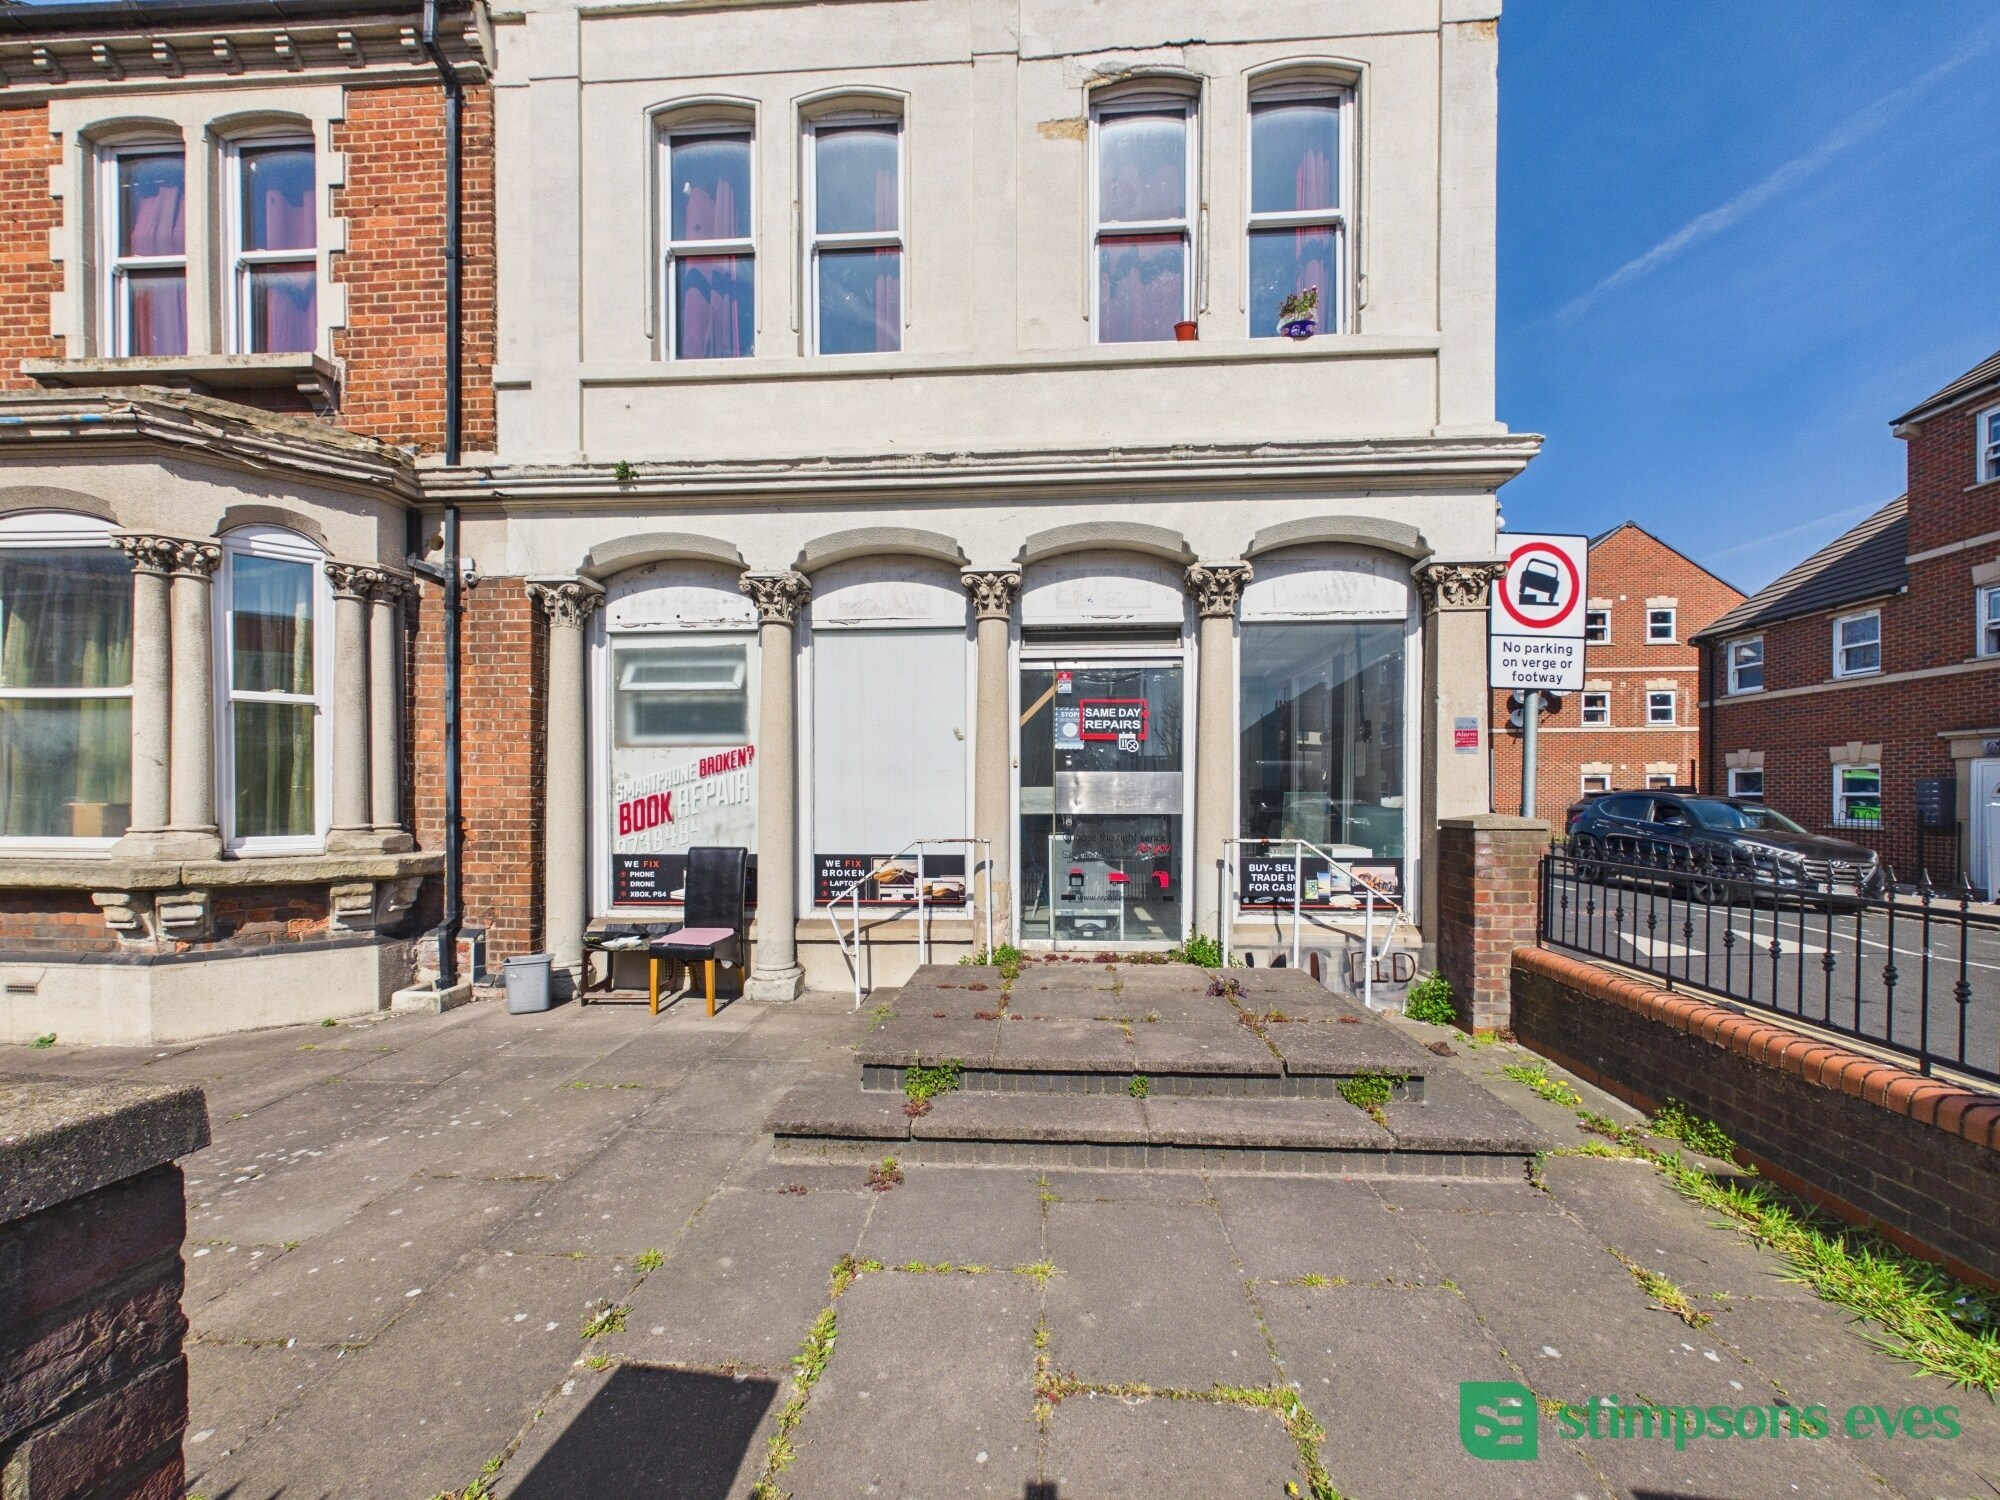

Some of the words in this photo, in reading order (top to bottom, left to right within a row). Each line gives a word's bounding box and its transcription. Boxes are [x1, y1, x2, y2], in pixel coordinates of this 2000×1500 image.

[1503, 642, 1521, 653] No
[1525, 643, 1573, 656] parking
[1502, 659, 1518, 667] on
[1522, 659, 1556, 670] verge
[1512, 671, 1563, 685] footway
[1085, 708, 1116, 717] SAME
[1118, 708, 1141, 717] DAY
[1085, 720, 1141, 729] REPAIRS
[616, 762, 698, 803] SMARTPHONE
[699, 745, 755, 778] BROKEN?
[619, 791, 673, 836] BOOK
[677, 770, 750, 820] REPAIR
[624, 860, 640, 868] WE
[643, 860, 660, 868] FIX
[825, 860, 841, 868] WE
[845, 860, 862, 868] FIX
[1275, 864, 1296, 872] SEL
[822, 869, 865, 877] BROKEN
[1250, 874, 1285, 882] TRADE
[1249, 884, 1270, 892] FOR
